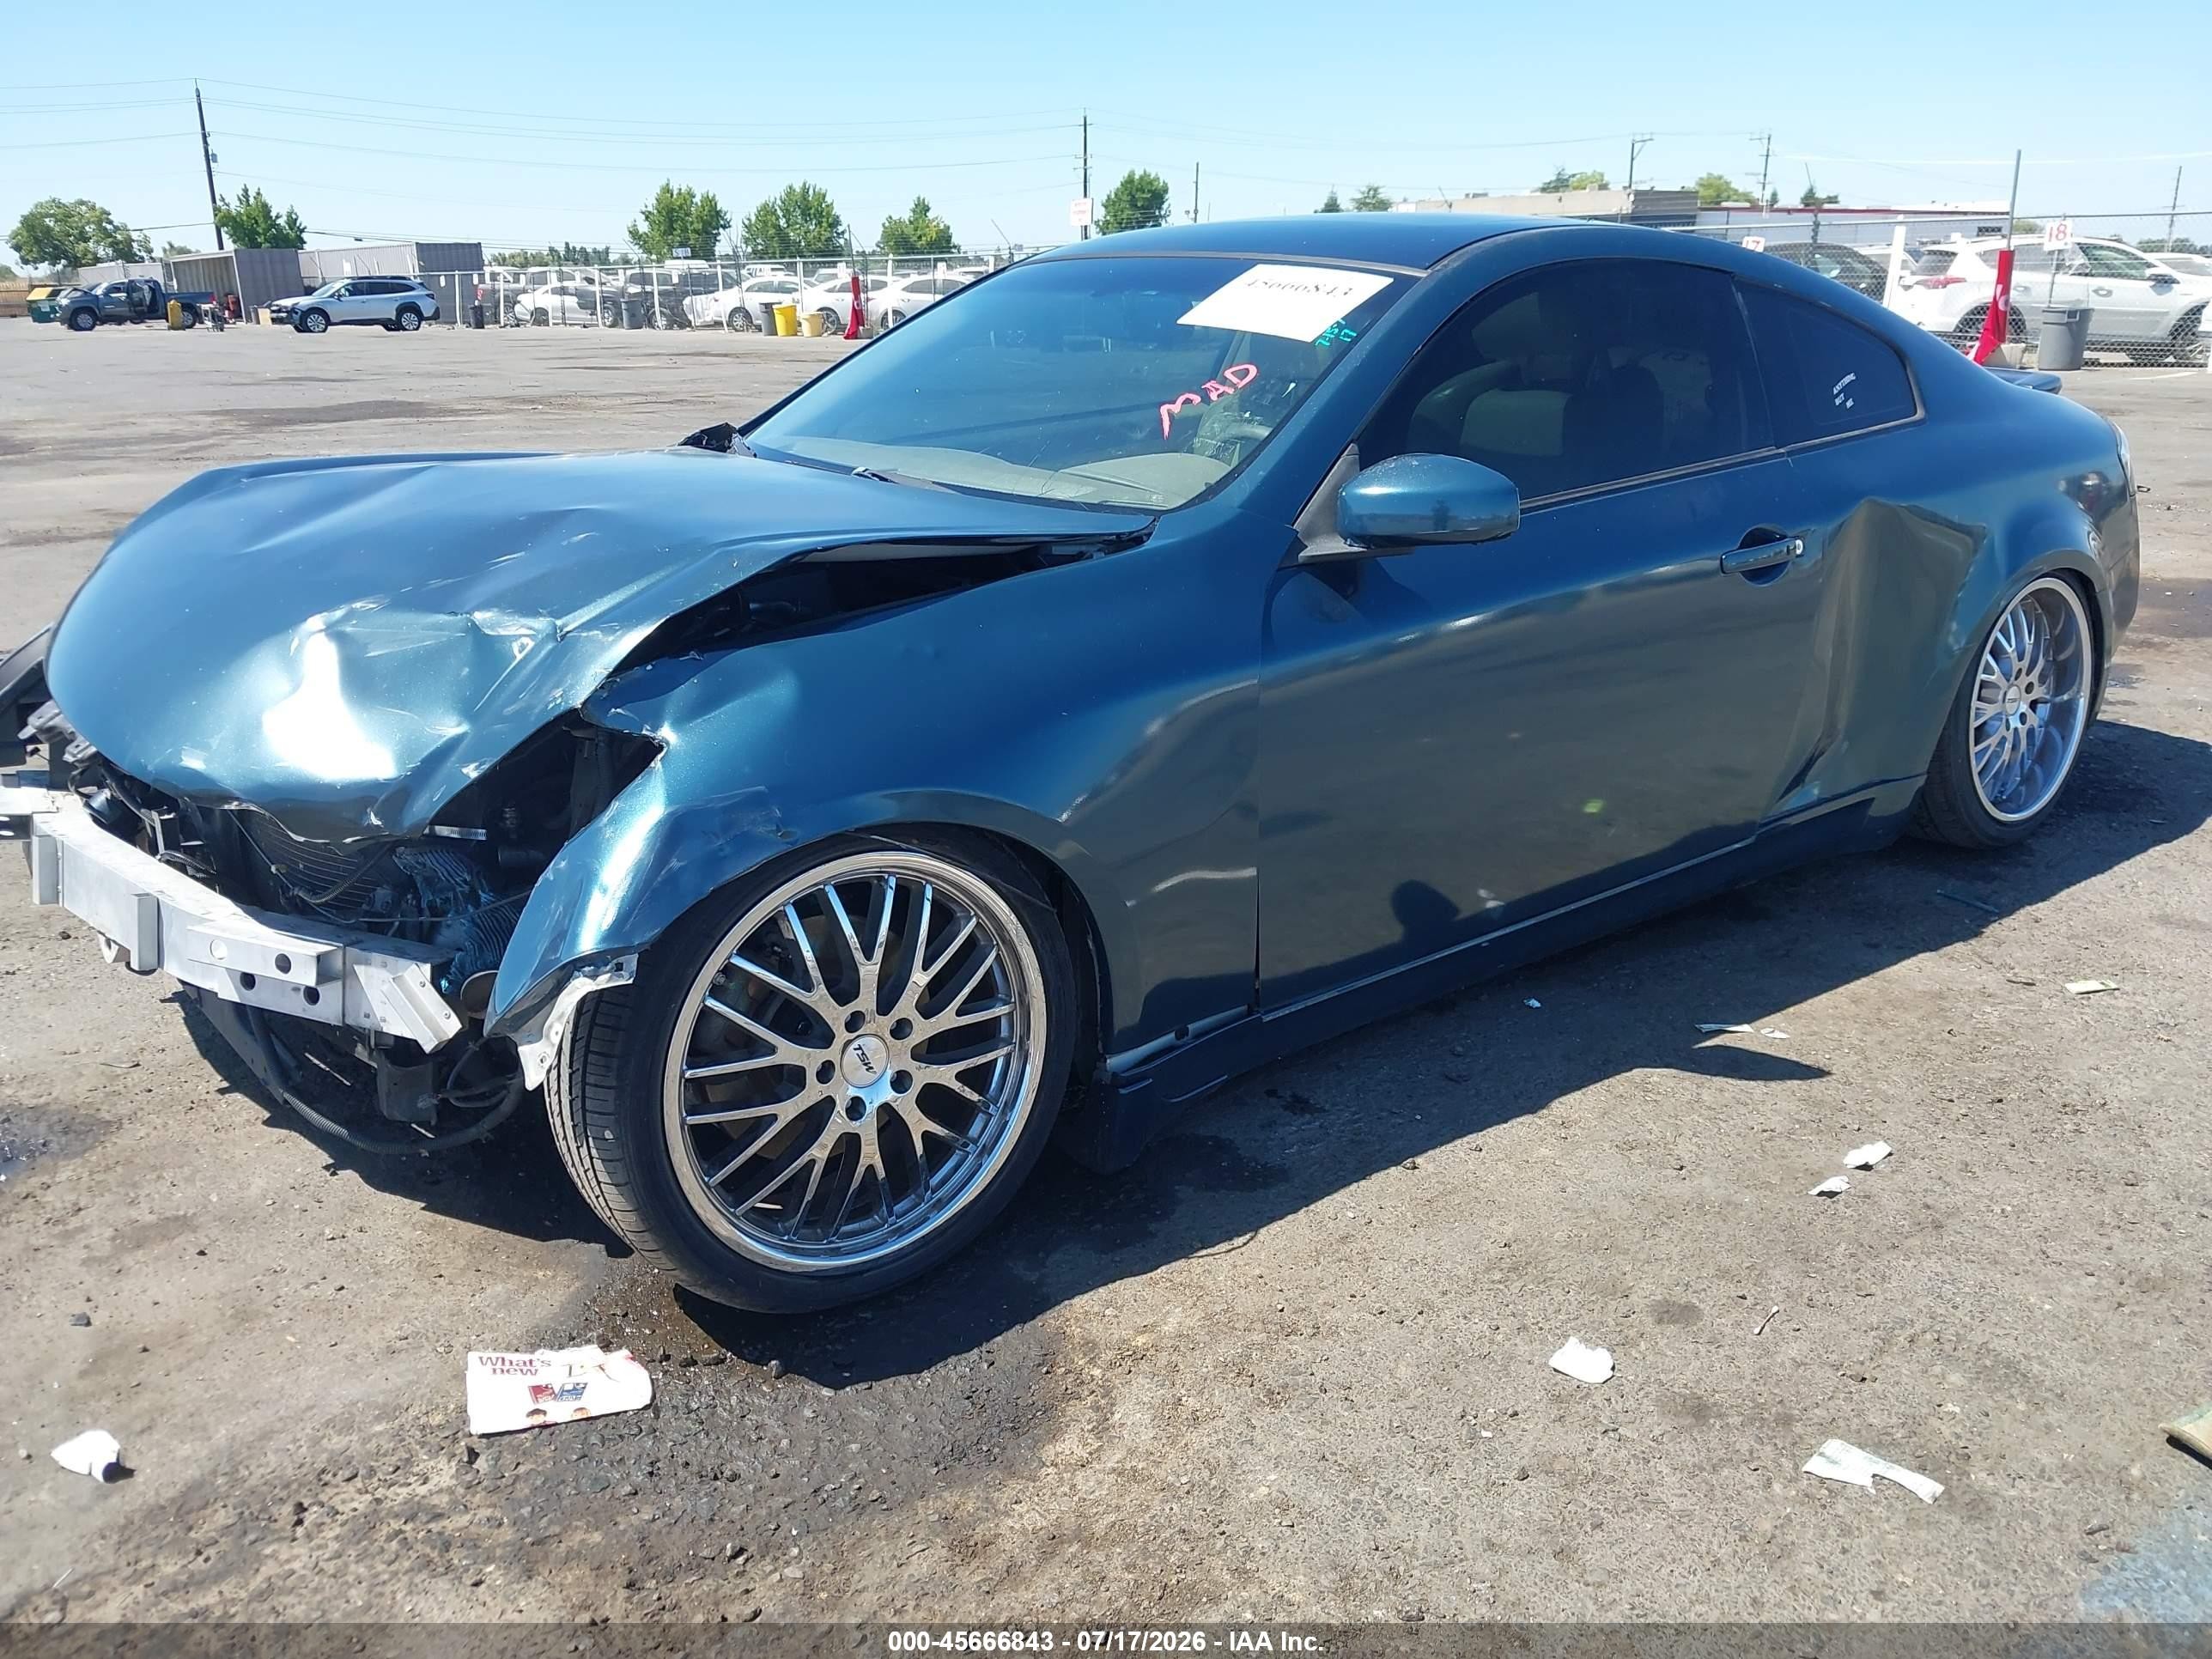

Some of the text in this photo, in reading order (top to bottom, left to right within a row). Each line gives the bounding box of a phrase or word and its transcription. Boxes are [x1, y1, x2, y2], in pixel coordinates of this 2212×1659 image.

[2048, 223, 2068, 243] 18
[1159, 363, 1258, 441] MAD
[853, 1043, 878, 1075] TSW
[478, 1356, 551, 1368] What's
[492, 1367, 538, 1376] new
